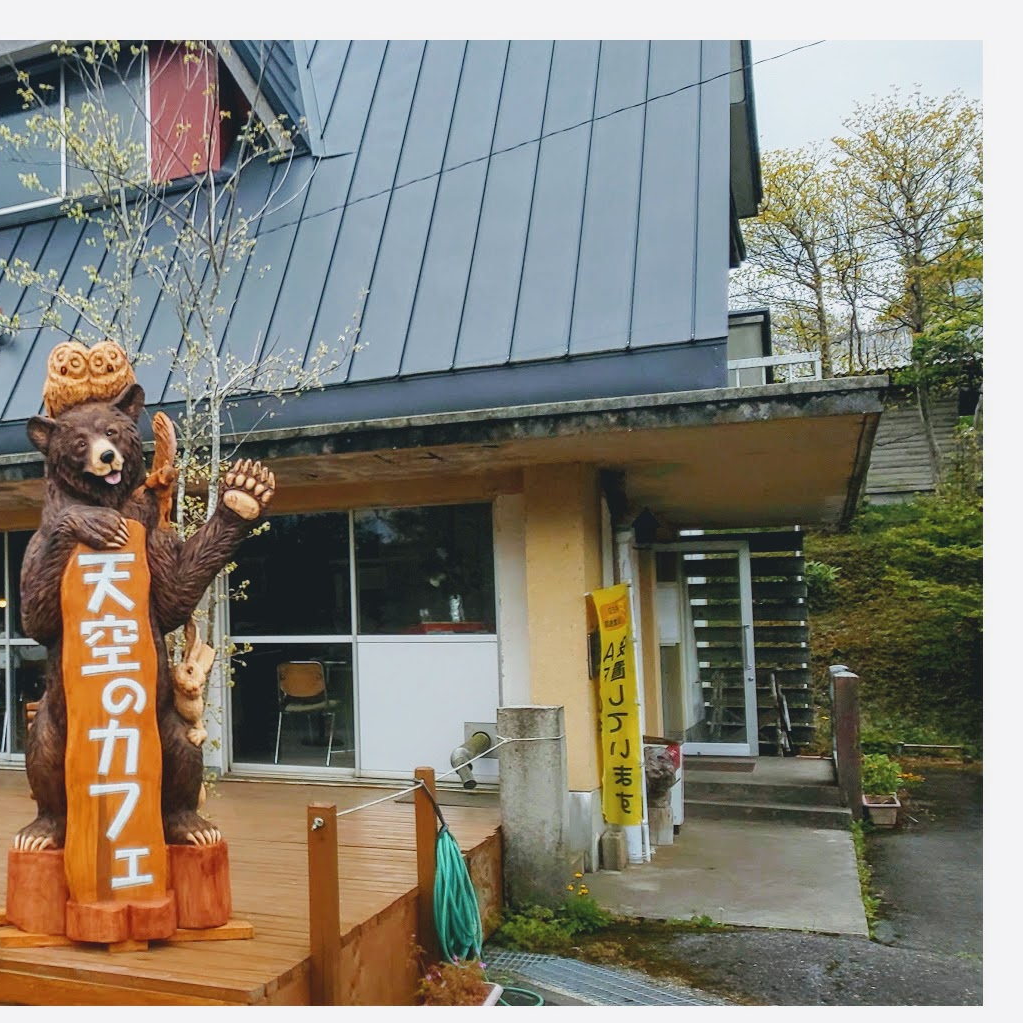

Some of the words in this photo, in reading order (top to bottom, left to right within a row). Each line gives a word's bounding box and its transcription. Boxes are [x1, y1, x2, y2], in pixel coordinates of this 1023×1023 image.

[77, 552, 154, 890] 天空のカフェ
